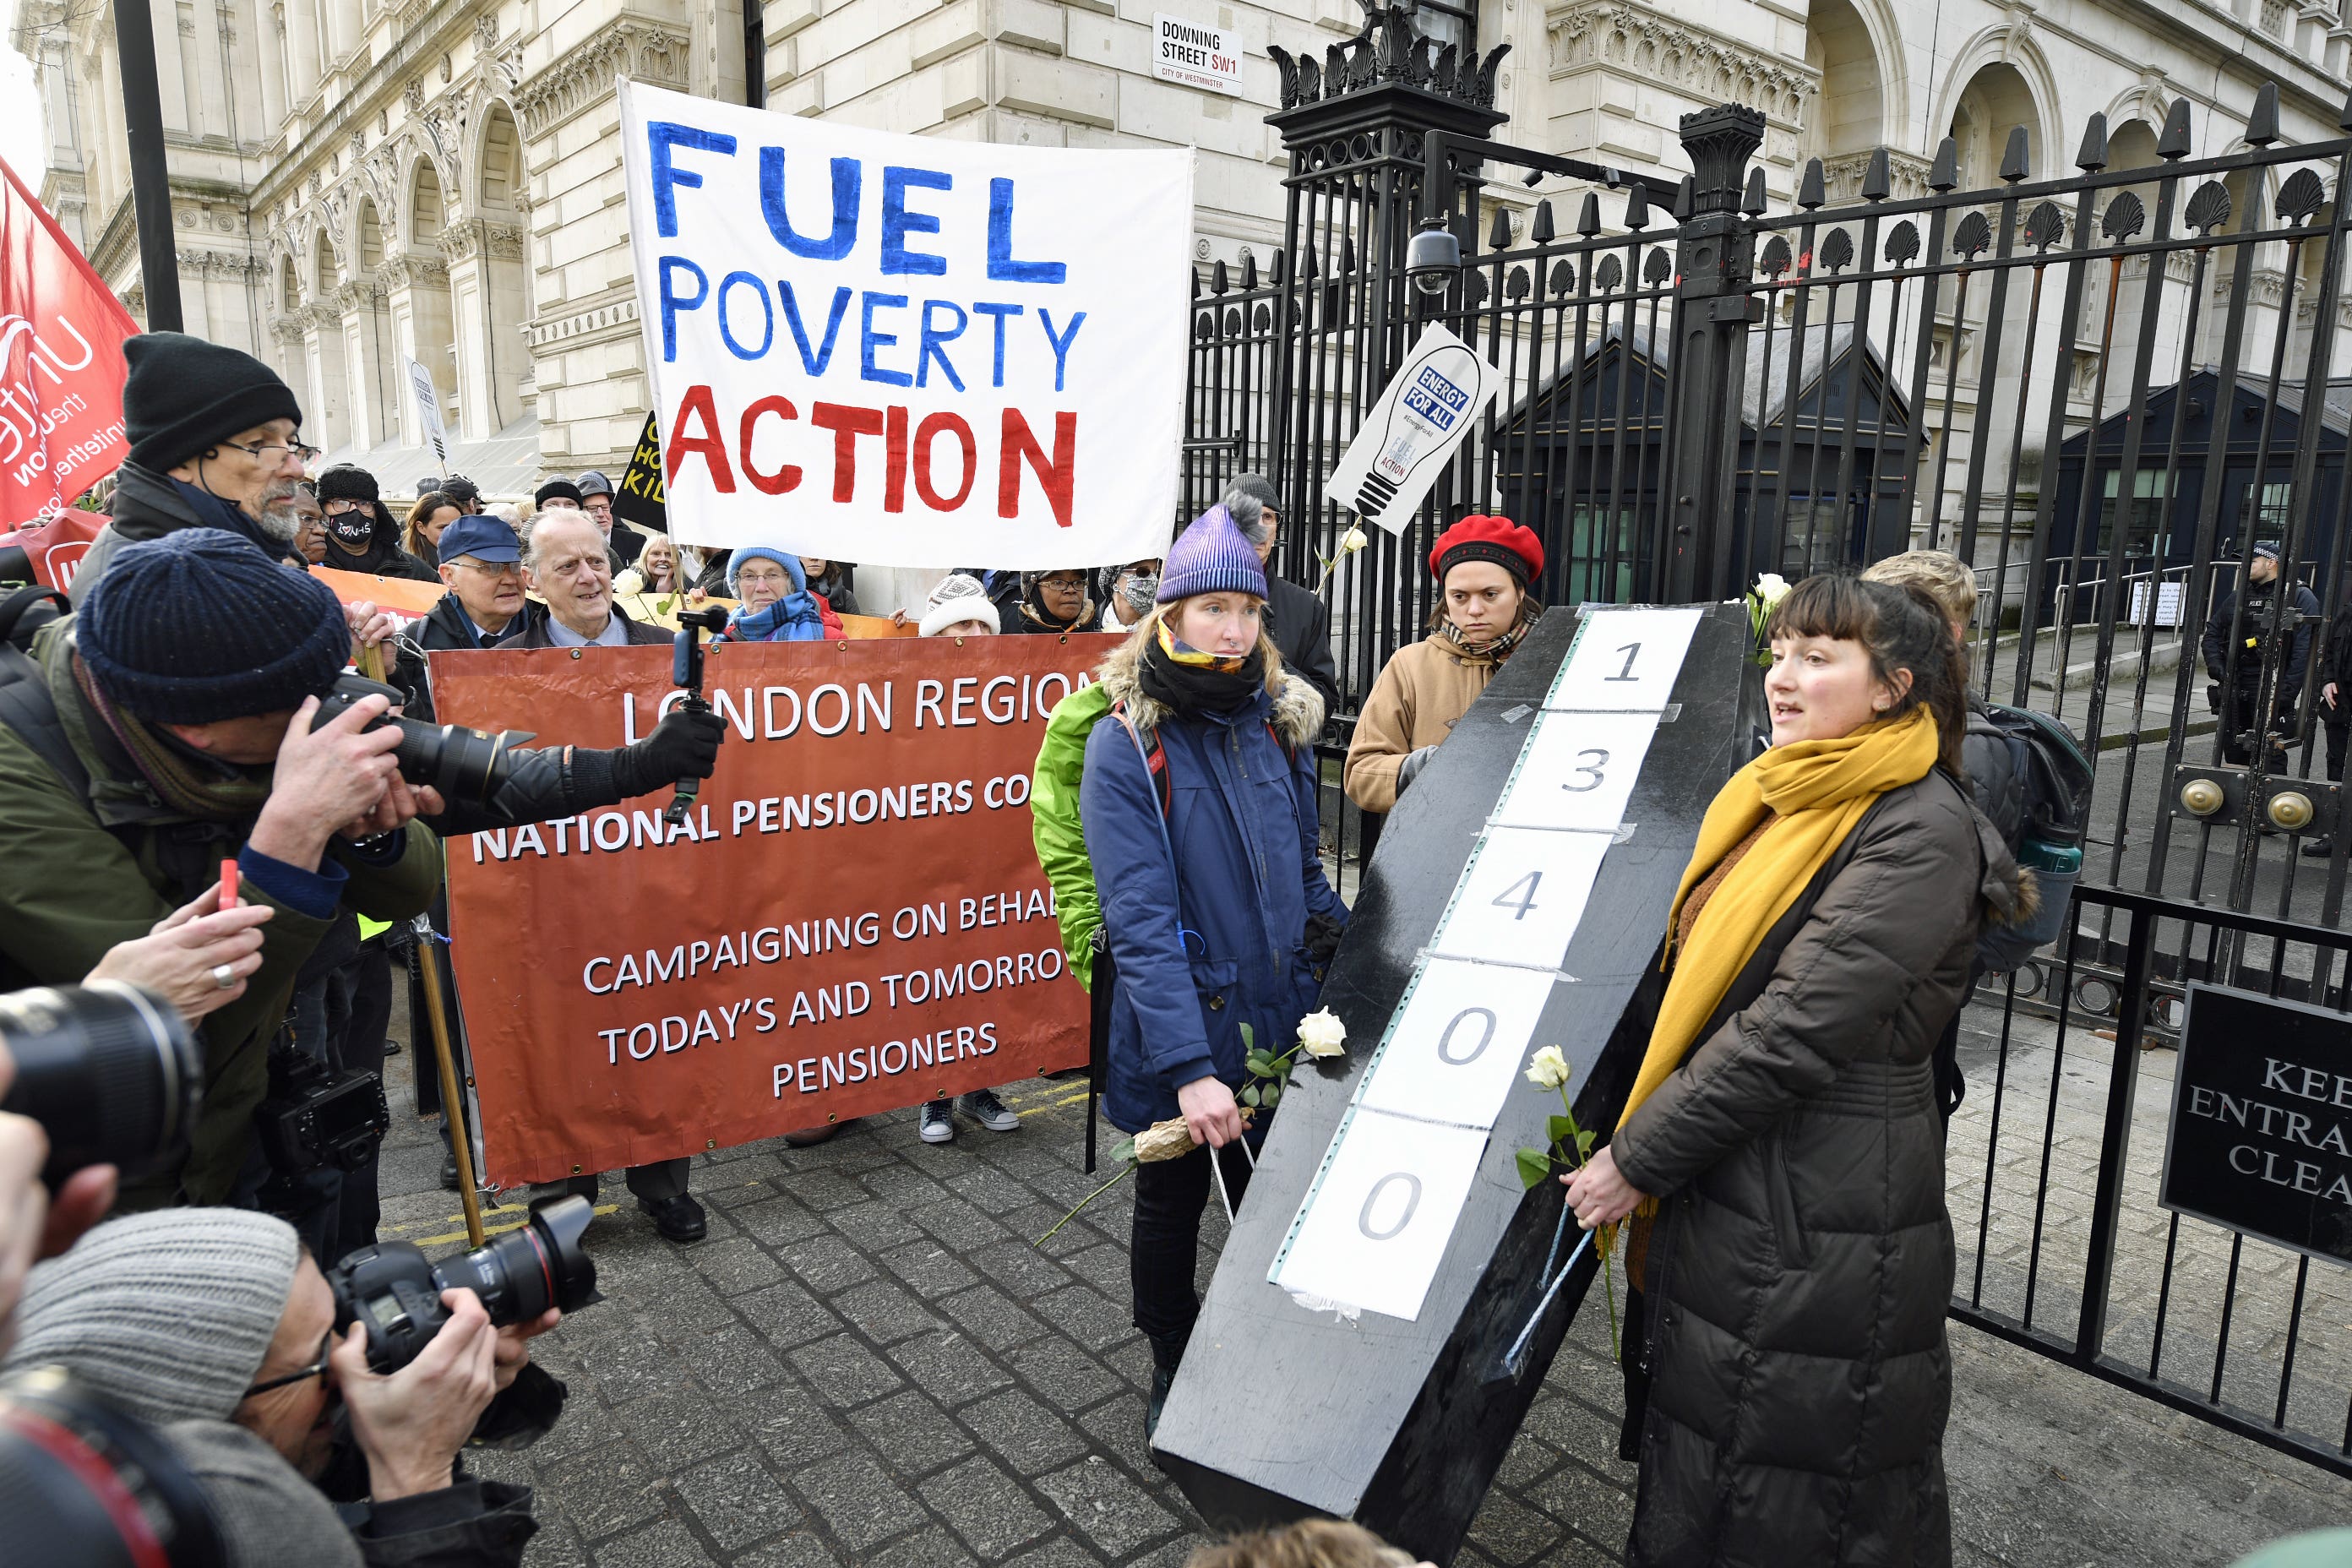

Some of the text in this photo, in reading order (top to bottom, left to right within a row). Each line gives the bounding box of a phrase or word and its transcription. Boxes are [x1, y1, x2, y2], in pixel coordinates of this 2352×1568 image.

[1162, 21, 1220, 51] DOWNING
[1162, 41, 1236, 74] STREET SW1
[1162, 68, 1223, 89] CITY OF WESTMINSTER
[647, 121, 1067, 284] FUEL
[658, 256, 1087, 393] POVERTY
[1407, 389, 1451, 428] FOR ALL
[1419, 369, 1467, 408] ENERGY
[1404, 415, 1435, 438] #EnergyForAll
[667, 385, 1077, 528] ACTION
[1380, 456, 1406, 477] ACTION
[1386, 448, 1411, 468] POVERTY
[1391, 437, 1417, 460] FUEL
[349, 521, 371, 537] NHS
[1603, 641, 1642, 683] 1
[1561, 749, 1612, 792] 3
[472, 804, 721, 863] NATIONAL
[733, 779, 974, 836] PENSIONERS
[1491, 871, 1544, 922] 4
[584, 912, 880, 994] CAMPAIGNING
[893, 901, 947, 939] ON
[789, 981, 871, 1026] AND
[879, 948, 1075, 1008] TOMORRO
[1438, 1006, 1498, 1066] 0
[774, 1022, 998, 1098] PENSIONERS
[1358, 1171, 1422, 1241] 0
